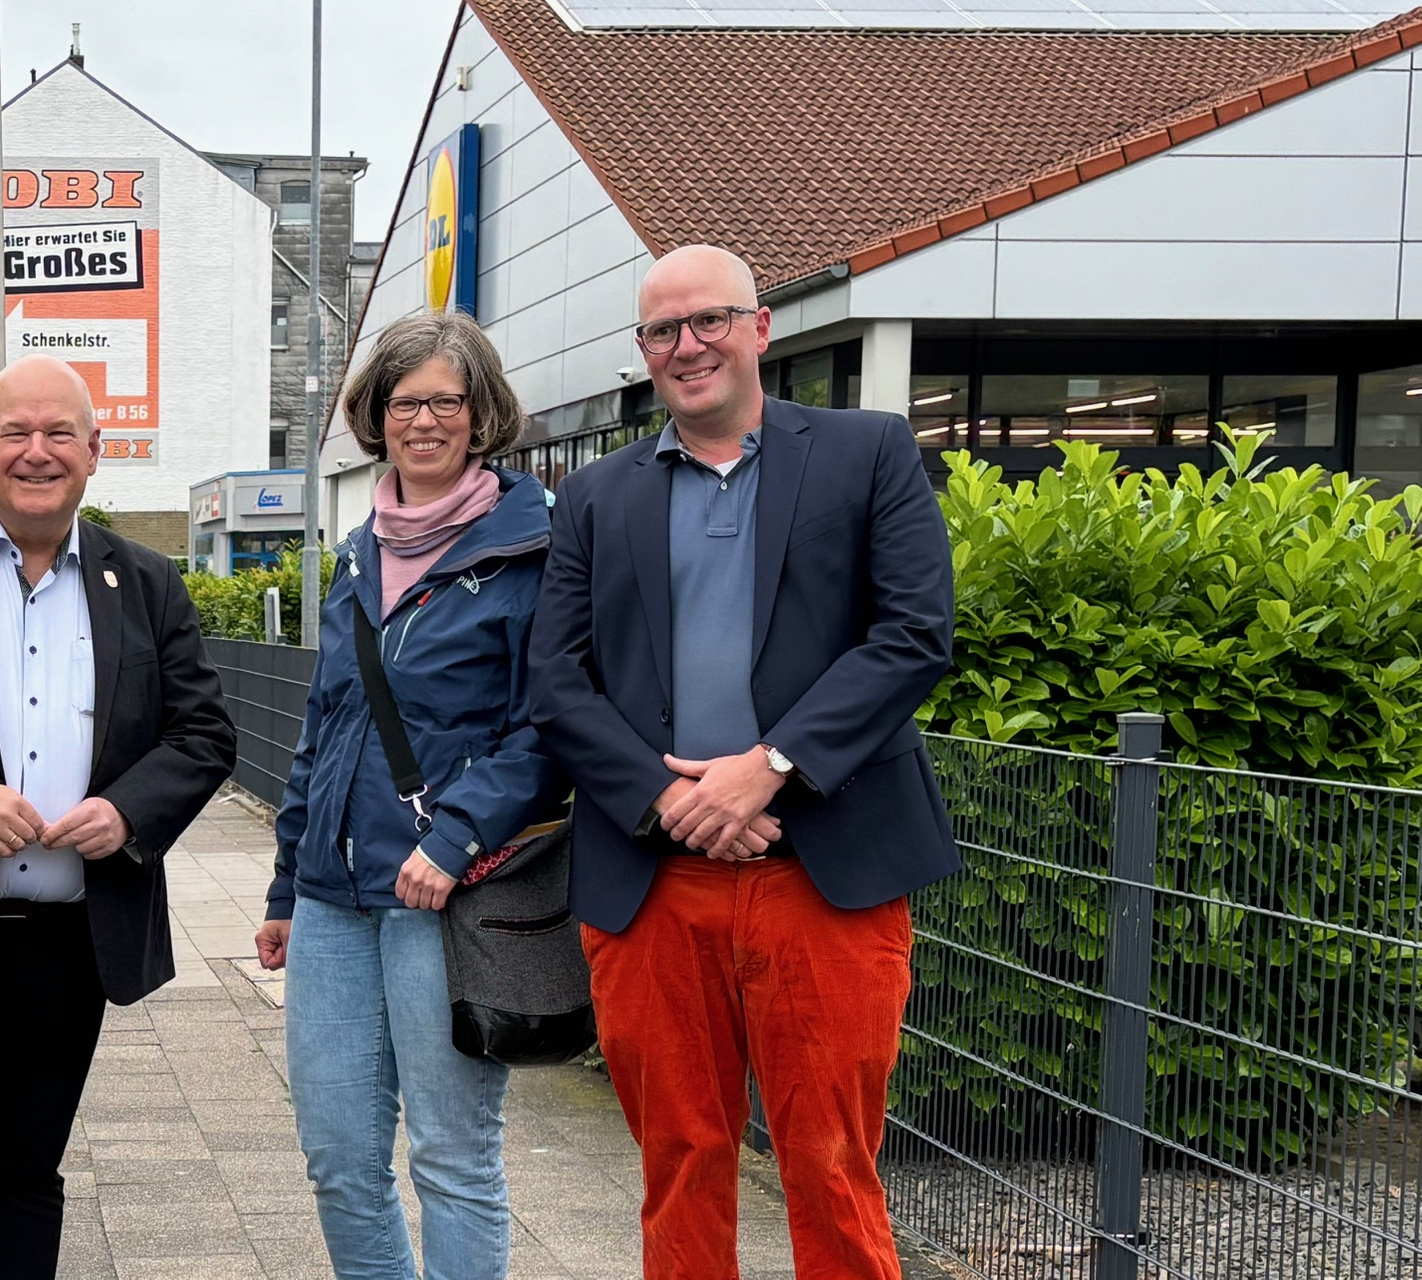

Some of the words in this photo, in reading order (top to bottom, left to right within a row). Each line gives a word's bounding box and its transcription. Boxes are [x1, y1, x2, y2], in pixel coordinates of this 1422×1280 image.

[3, 170, 144, 209] OBI
[3, 235, 31, 247] Hier
[35, 230, 99, 246] erwartet
[103, 229, 127, 242] Sie
[429, 214, 450, 252] DL
[4, 247, 128, 280] Großes
[22, 332, 111, 348] Schenkelstr.
[100, 439, 153, 459] BI
